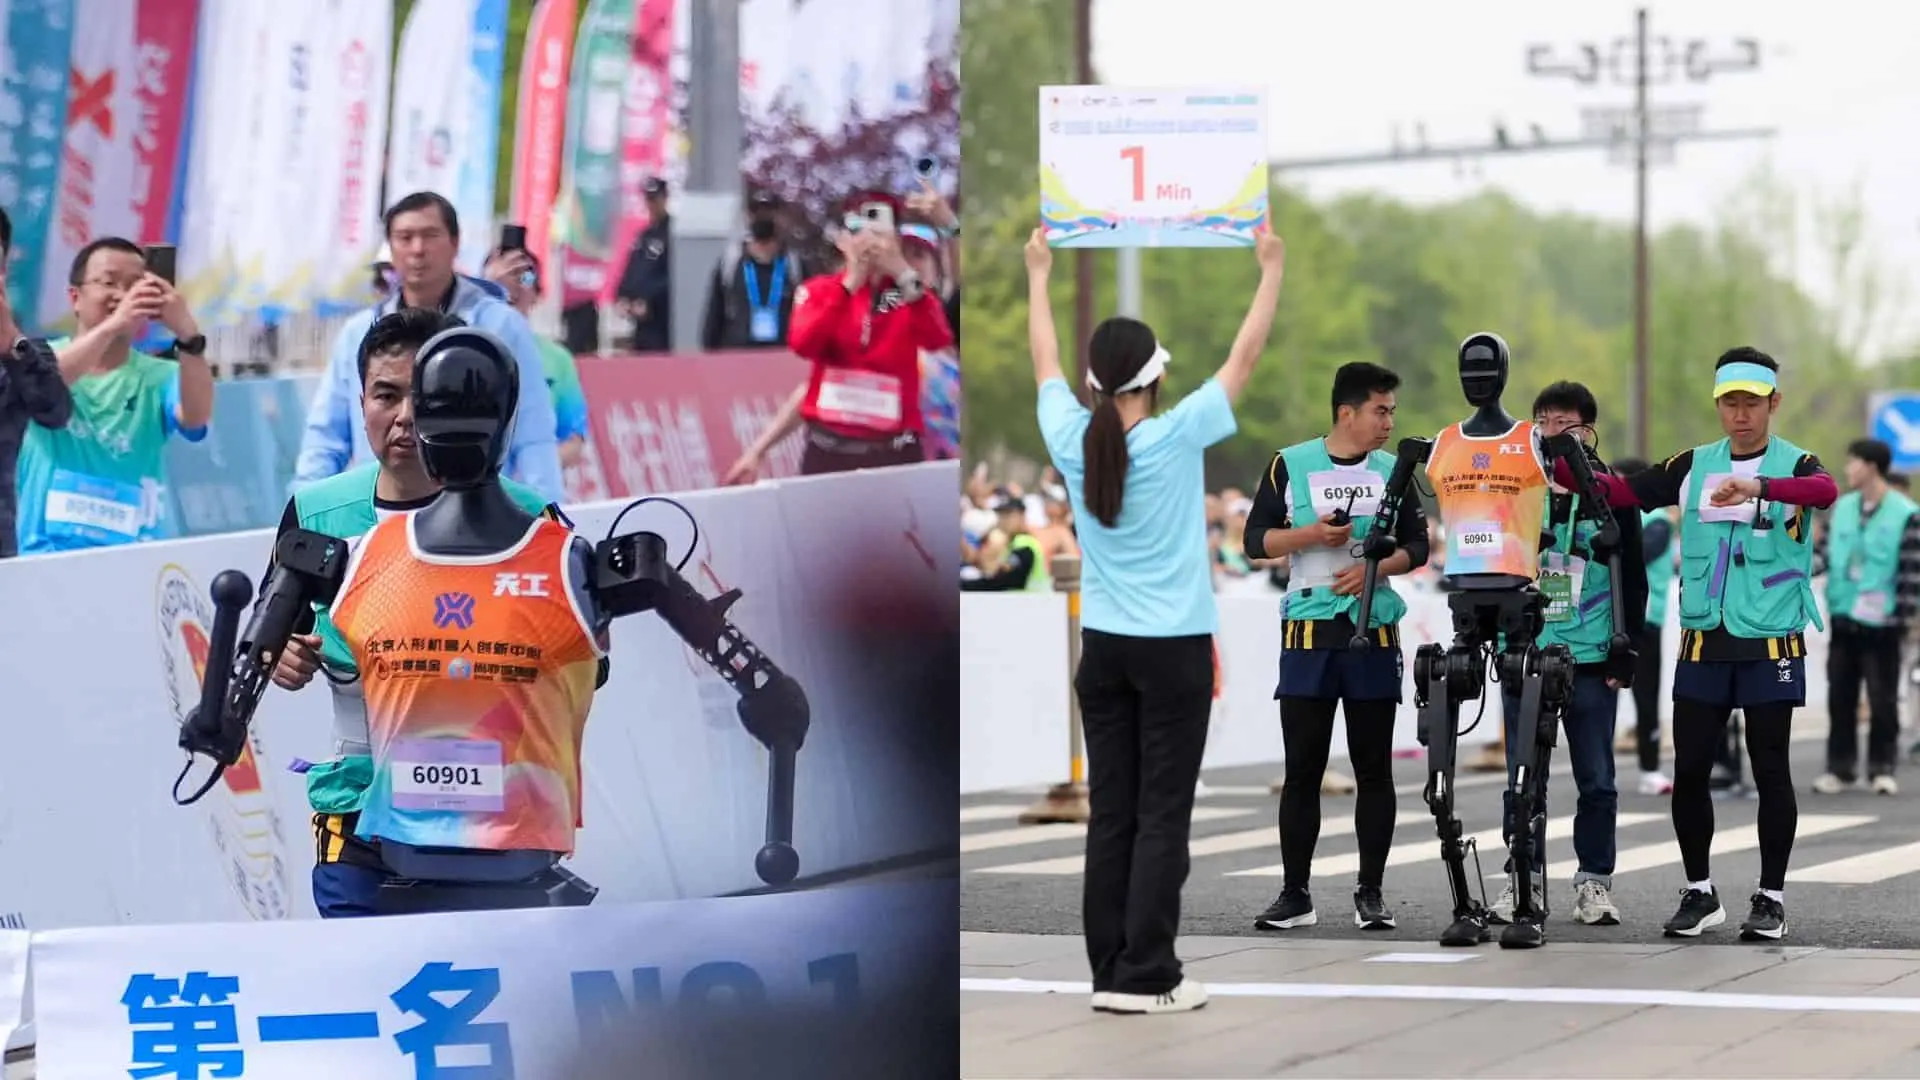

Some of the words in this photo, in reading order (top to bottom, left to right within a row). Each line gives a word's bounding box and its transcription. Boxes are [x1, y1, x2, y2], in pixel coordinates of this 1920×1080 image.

[1120, 145, 1145, 201] 1
[1156, 183, 1192, 201] Min
[1324, 486, 1374, 500] 60901
[1464, 533, 1493, 545] 60901
[493, 571, 550, 598] 天工
[413, 766, 483, 786] 60901
[120, 961, 514, 1080] 第一名
